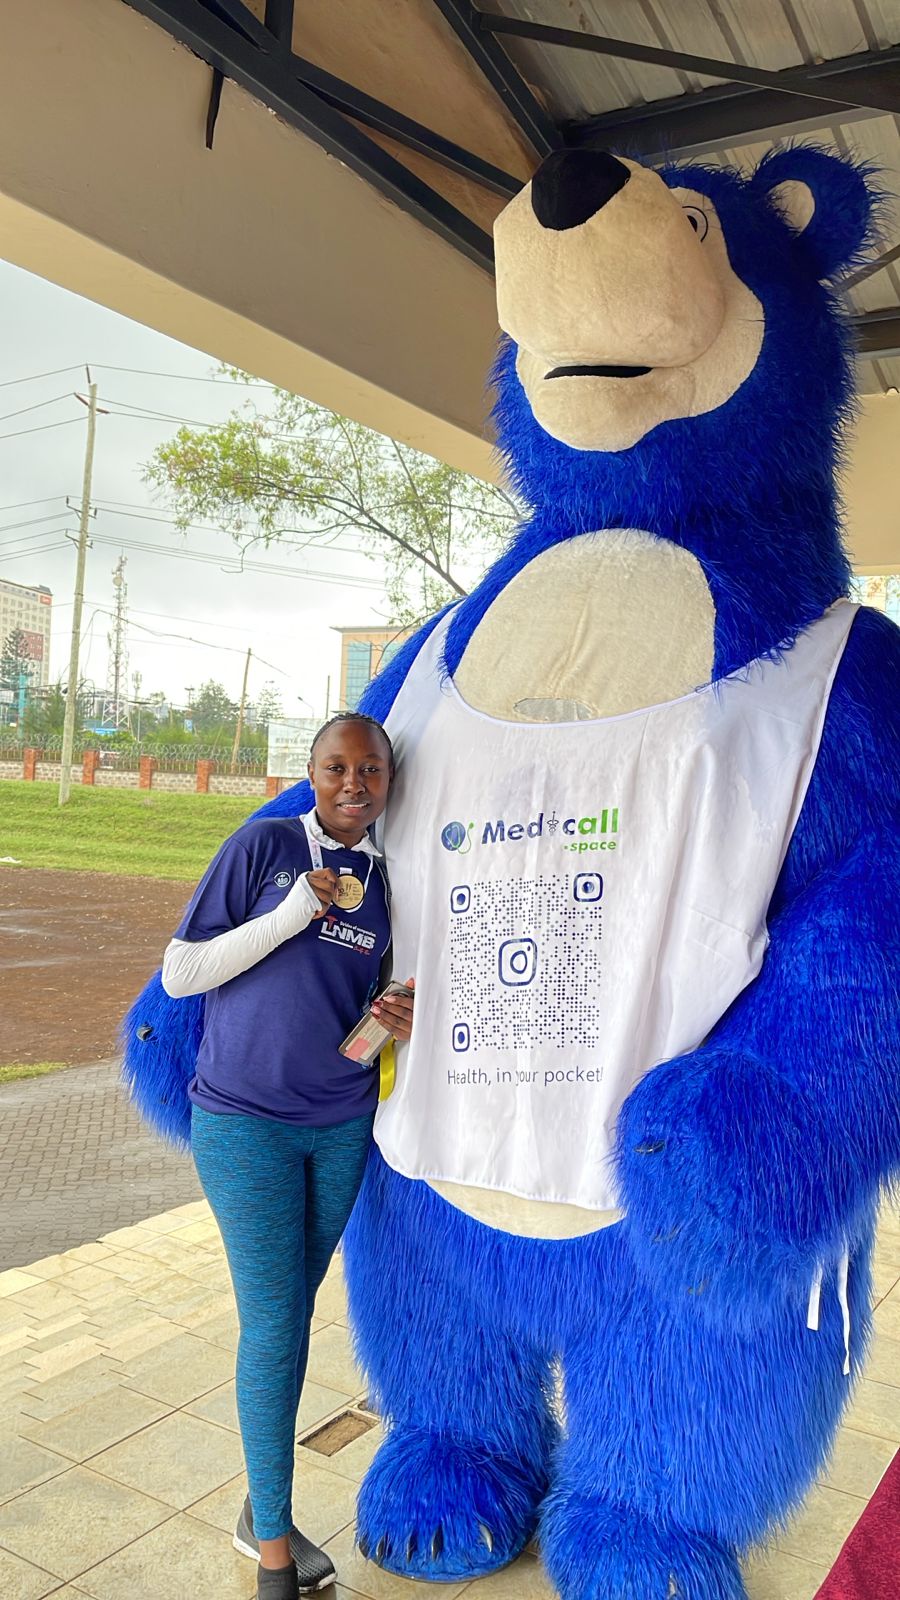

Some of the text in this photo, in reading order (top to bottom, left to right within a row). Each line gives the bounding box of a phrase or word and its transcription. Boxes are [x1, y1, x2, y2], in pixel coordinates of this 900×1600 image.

[447, 1065, 604, 1087] Health, in your pocket!
